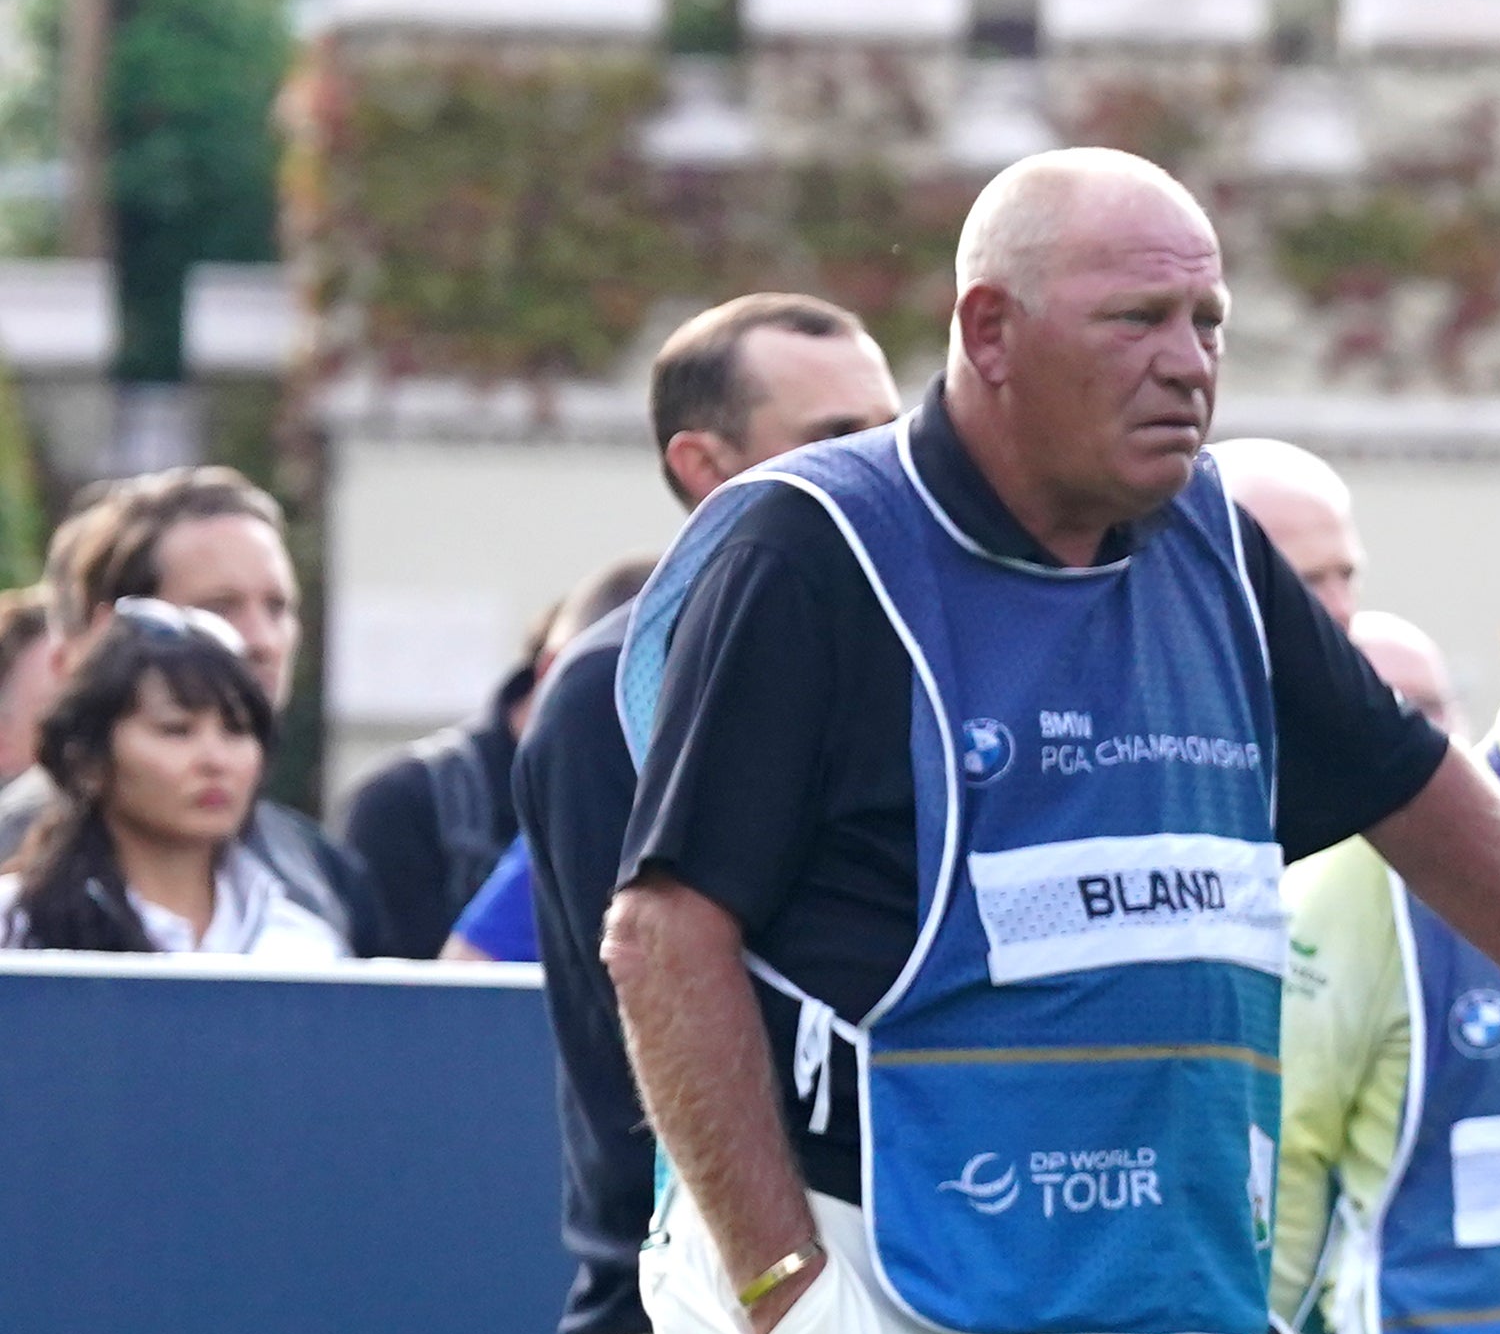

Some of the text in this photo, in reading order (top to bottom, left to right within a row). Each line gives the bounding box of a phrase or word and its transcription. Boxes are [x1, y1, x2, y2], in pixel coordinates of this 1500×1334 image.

[1039, 710, 1093, 740] BMW
[1040, 734, 1261, 775] PGA CHAMPIONSHIP
[1077, 867, 1226, 919] BLAND
[1029, 1146, 1158, 1173] DP WORLD
[1031, 1168, 1163, 1218] TOUR
